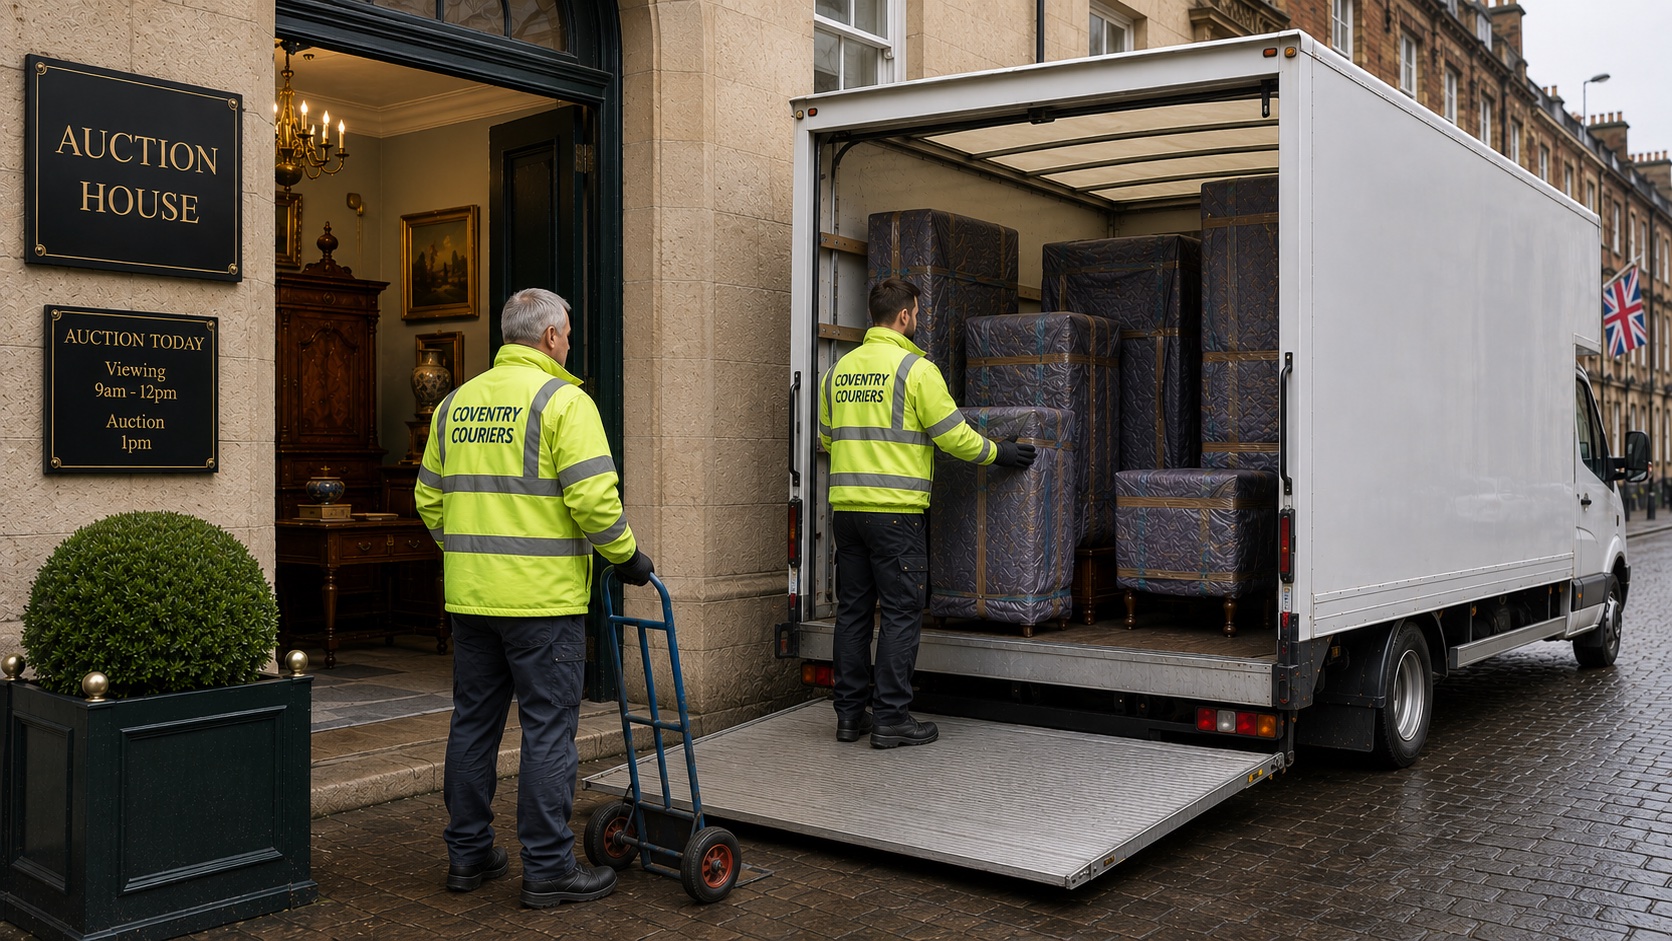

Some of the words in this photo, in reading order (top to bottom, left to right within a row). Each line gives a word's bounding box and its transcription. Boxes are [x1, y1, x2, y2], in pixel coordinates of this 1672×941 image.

[55, 125, 219, 174] AUCTION
[80, 181, 200, 224] HOUSE
[64, 328, 145, 347] AUCTION
[150, 333, 205, 351] TODAY
[105, 361, 166, 382] Viewing
[835, 373, 889, 387] COVENTRY
[95, 382, 127, 399] 9am
[140, 384, 177, 404] 12pm
[835, 389, 884, 403] COURIERS
[106, 413, 165, 430] Auction
[453, 406, 522, 423] COVENTRY
[121, 434, 152, 452] 1pm
[452, 427, 513, 444] COURIERS
